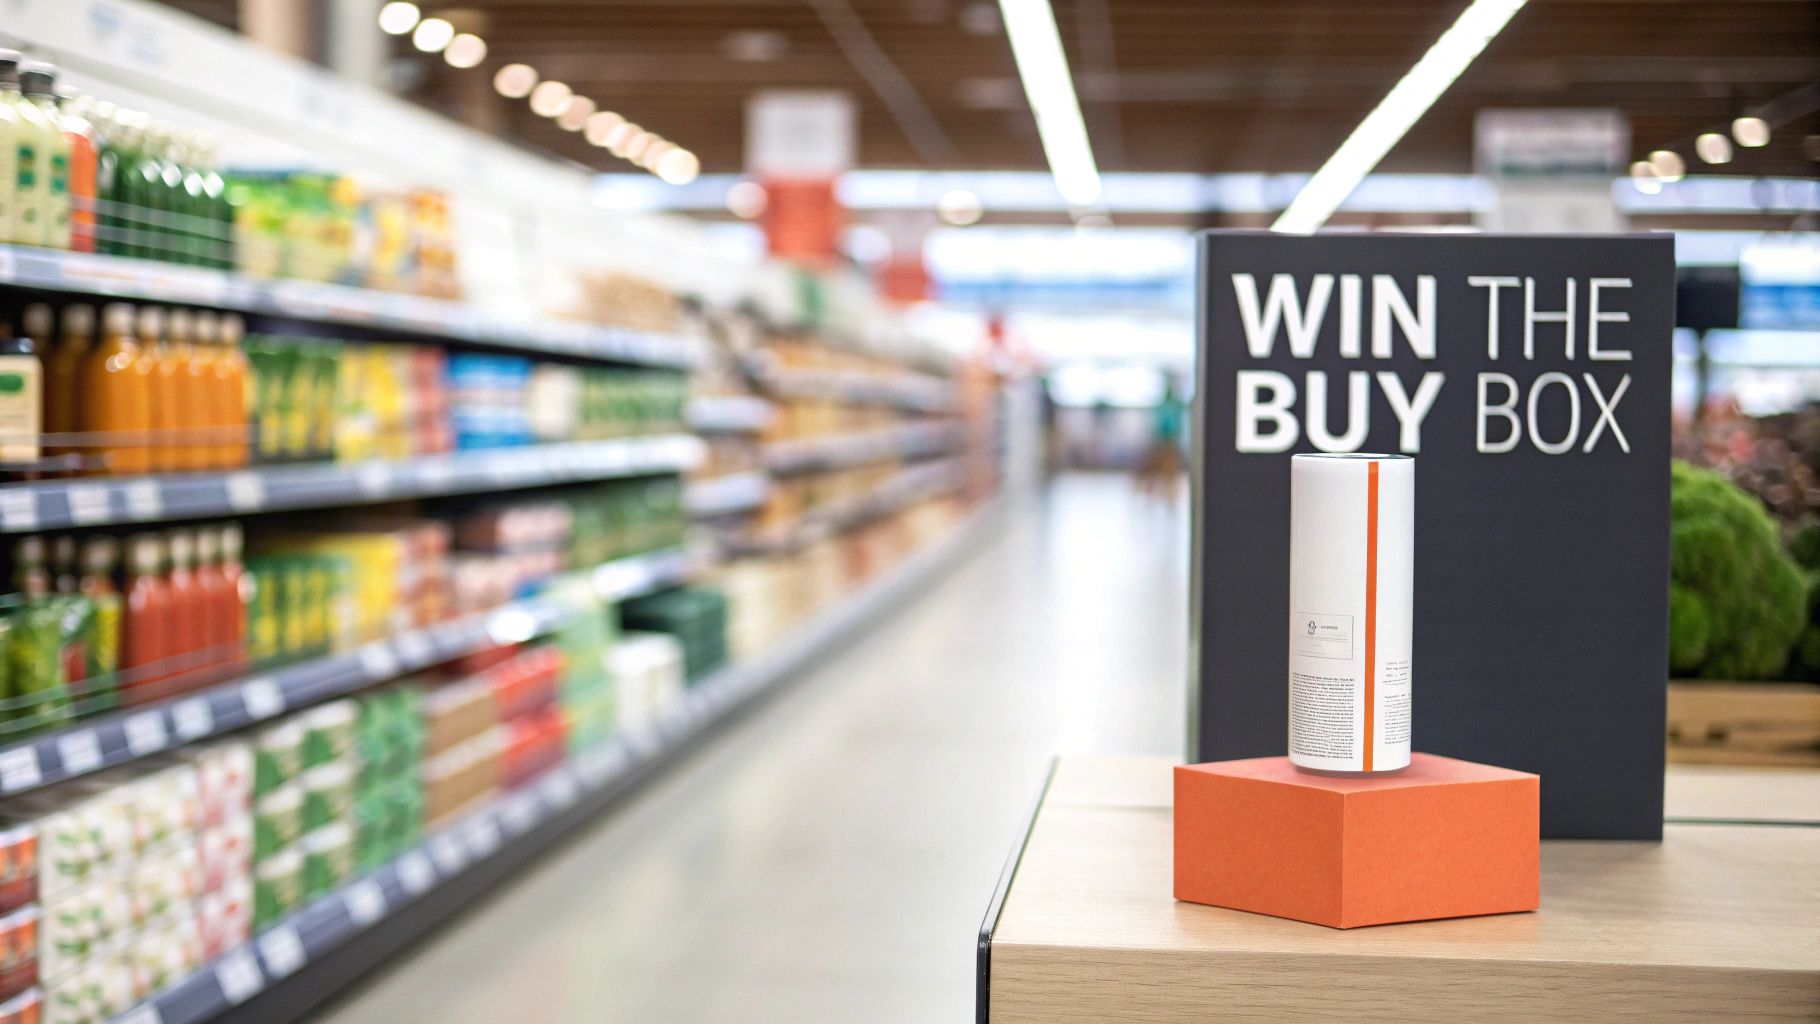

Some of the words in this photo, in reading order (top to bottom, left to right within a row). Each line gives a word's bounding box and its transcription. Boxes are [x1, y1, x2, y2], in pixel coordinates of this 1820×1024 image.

[1232, 273, 1436, 358] WIN
[1468, 276, 1632, 360] THE
[1236, 370, 1444, 453] BUY
[1477, 373, 1630, 454] BOX
